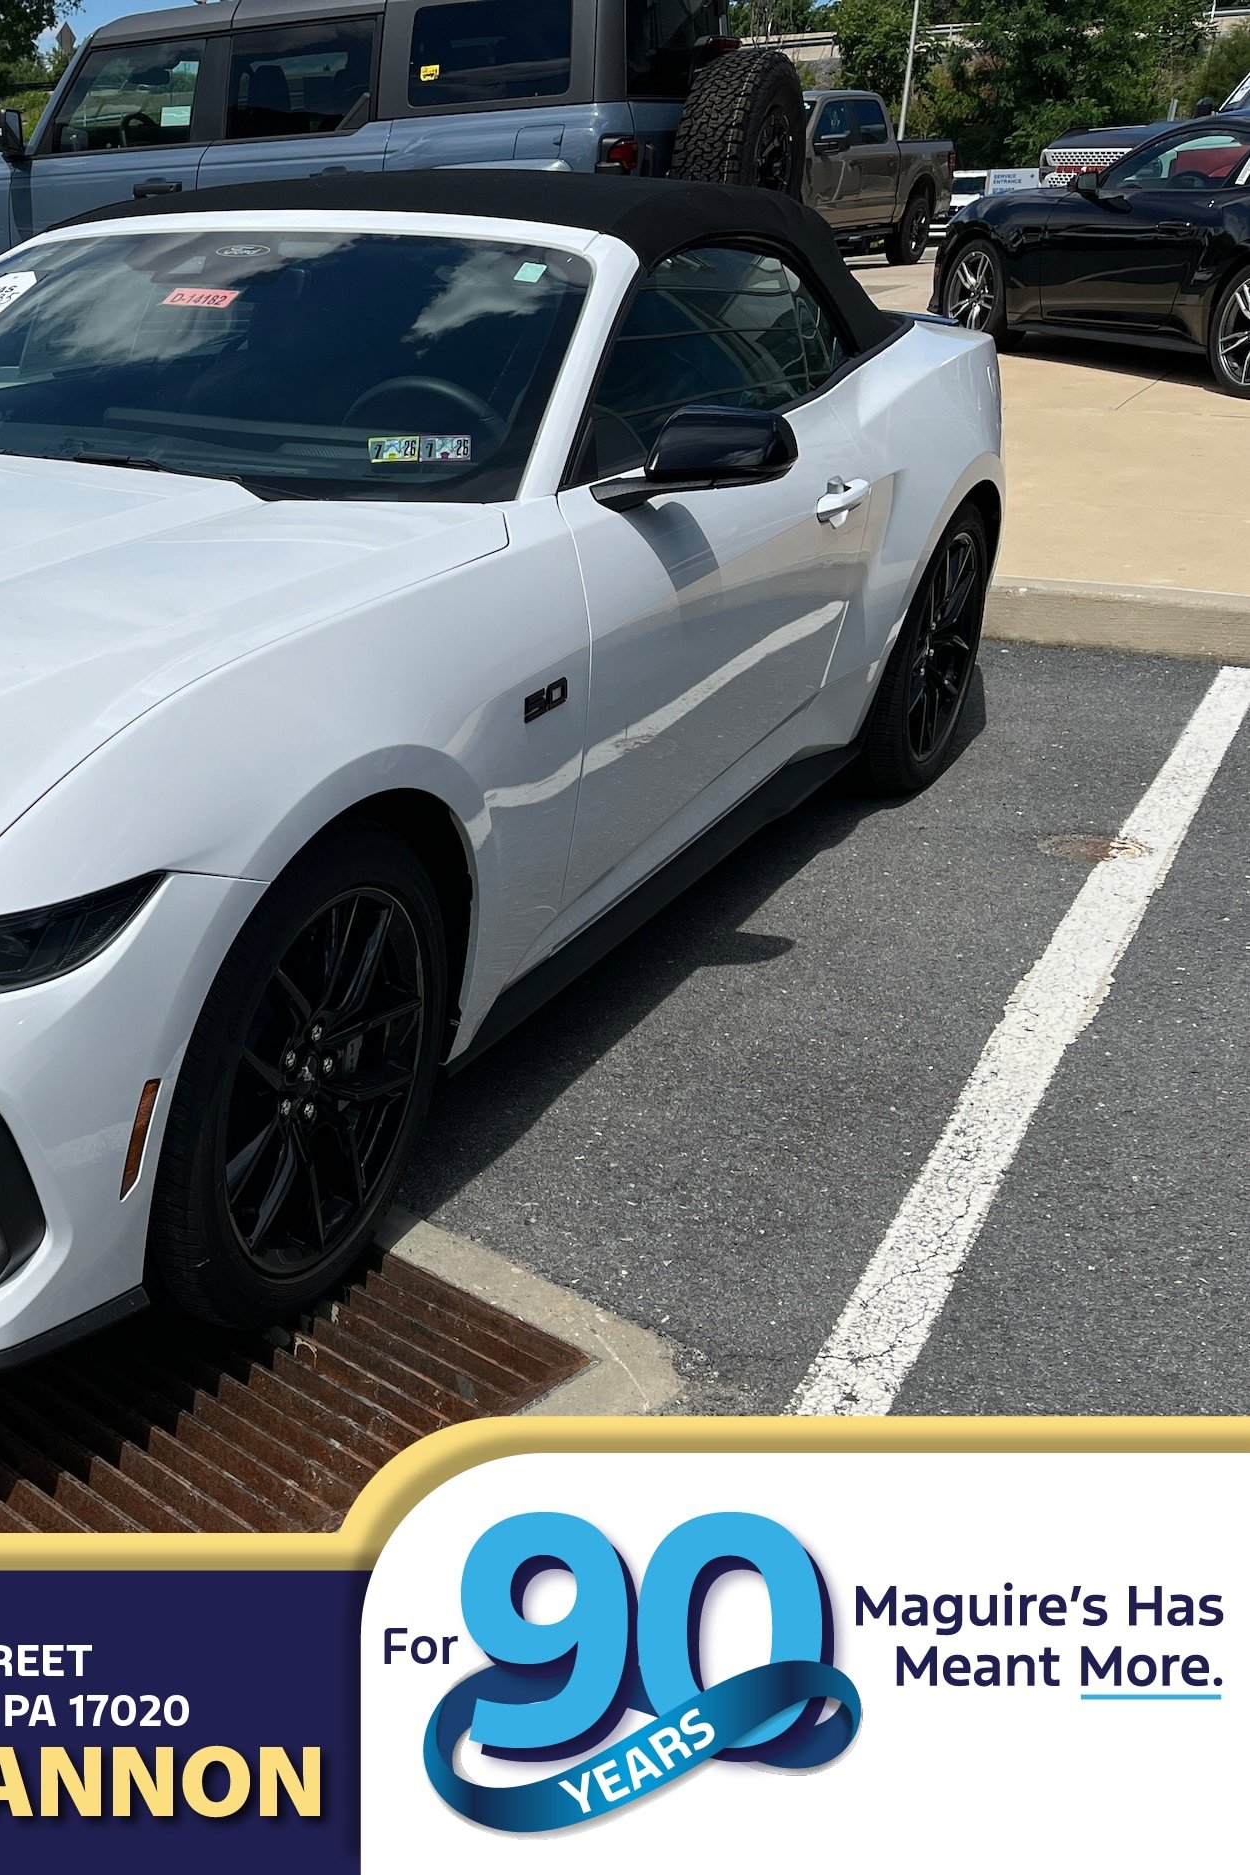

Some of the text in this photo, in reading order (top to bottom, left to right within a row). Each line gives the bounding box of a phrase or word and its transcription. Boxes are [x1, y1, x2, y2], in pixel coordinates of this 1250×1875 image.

[223, 246, 262, 255] Ford
[170, 293, 227, 306] D-14182
[374, 444, 382, 460] 7
[425, 443, 434, 458] 7
